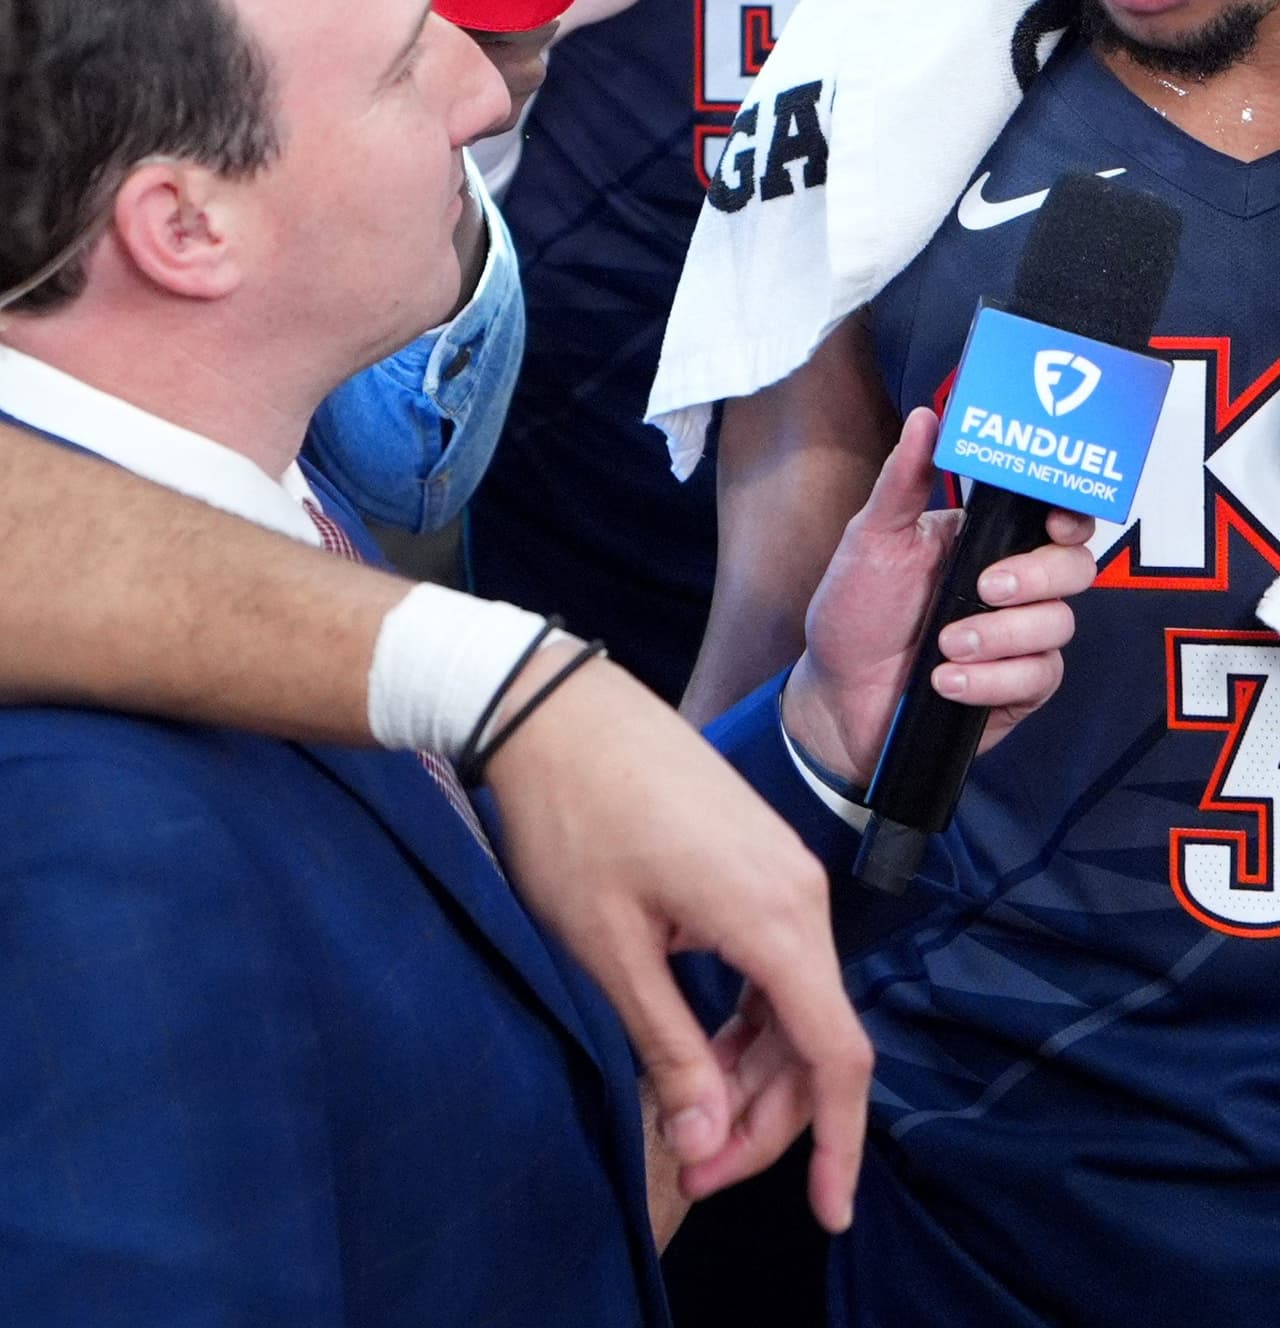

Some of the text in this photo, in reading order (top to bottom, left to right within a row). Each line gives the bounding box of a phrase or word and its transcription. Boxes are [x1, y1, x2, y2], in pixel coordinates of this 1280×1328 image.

[954, 438, 1119, 504] SPORTS NETWORK
[960, 405, 1125, 482] FANDUEL
